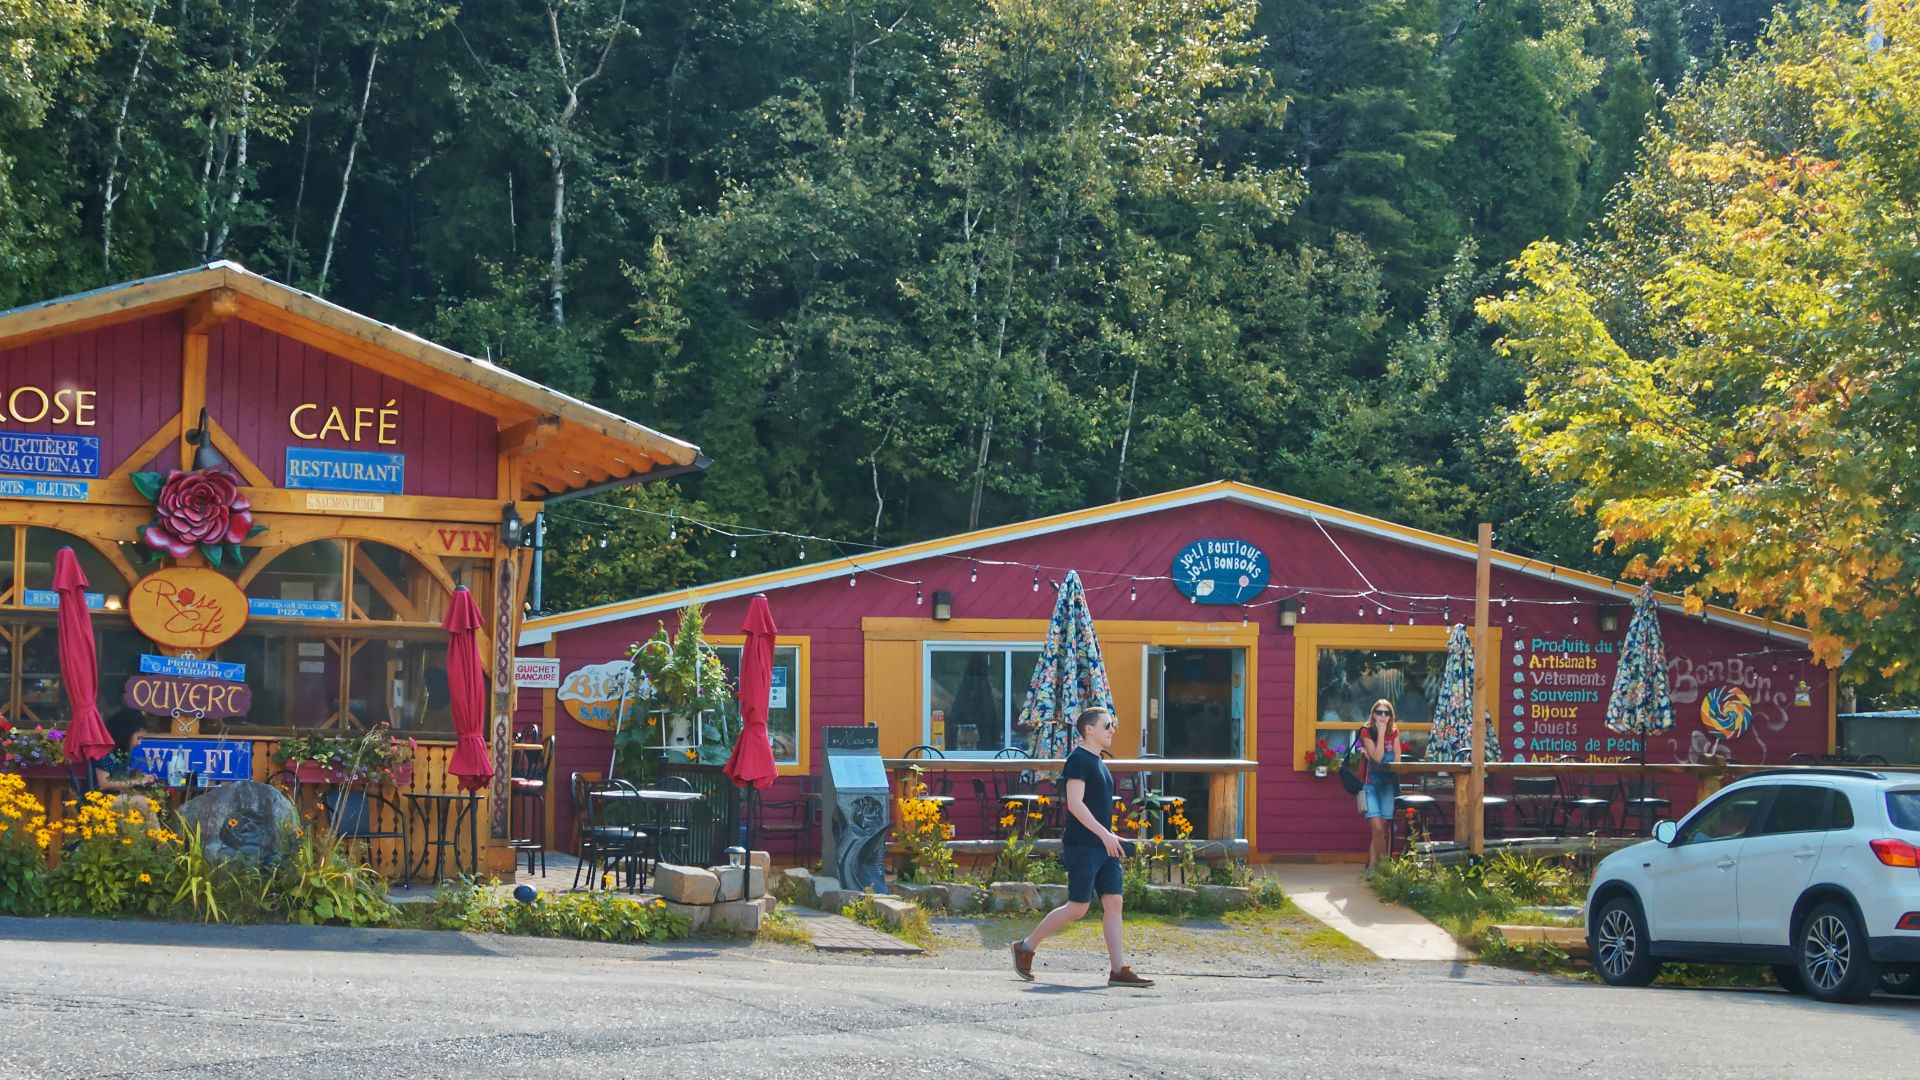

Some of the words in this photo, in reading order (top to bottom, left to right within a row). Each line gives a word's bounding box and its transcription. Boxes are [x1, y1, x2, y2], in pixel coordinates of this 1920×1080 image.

[0, 386, 97, 426] OSE
[289, 399, 399, 445] CAFÉ
[0, 437, 78, 456] URTIÈRE
[0, 454, 94, 474] SAGUENAY
[289, 459, 400, 481] RESTAURANT
[36, 481, 80, 497] BLEUETS
[438, 528, 494, 552] VIN
[1214, 556, 1261, 579] BONBONS
[277, 608, 305, 616] PIZZA
[1531, 638, 1590, 653] Produits
[1595, 640, 1612, 653] du
[167, 659, 219, 670] PRODUITS
[517, 665, 556, 673] GUICHET
[1529, 655, 1597, 669] Artisanats
[177, 667, 222, 678] TERROIR
[515, 673, 556, 681] BANCAIRE
[1530, 671, 1606, 686] Vêtements
[133, 680, 243, 713] OUVERT
[1530, 689, 1599, 702] Souvenirs
[1531, 704, 1578, 722] Bijoux
[1531, 721, 1577, 735] Jouets
[1530, 738, 1577, 752] Articles
[1585, 738, 1600, 752] de
[1607, 738, 1647, 752] Pêch
